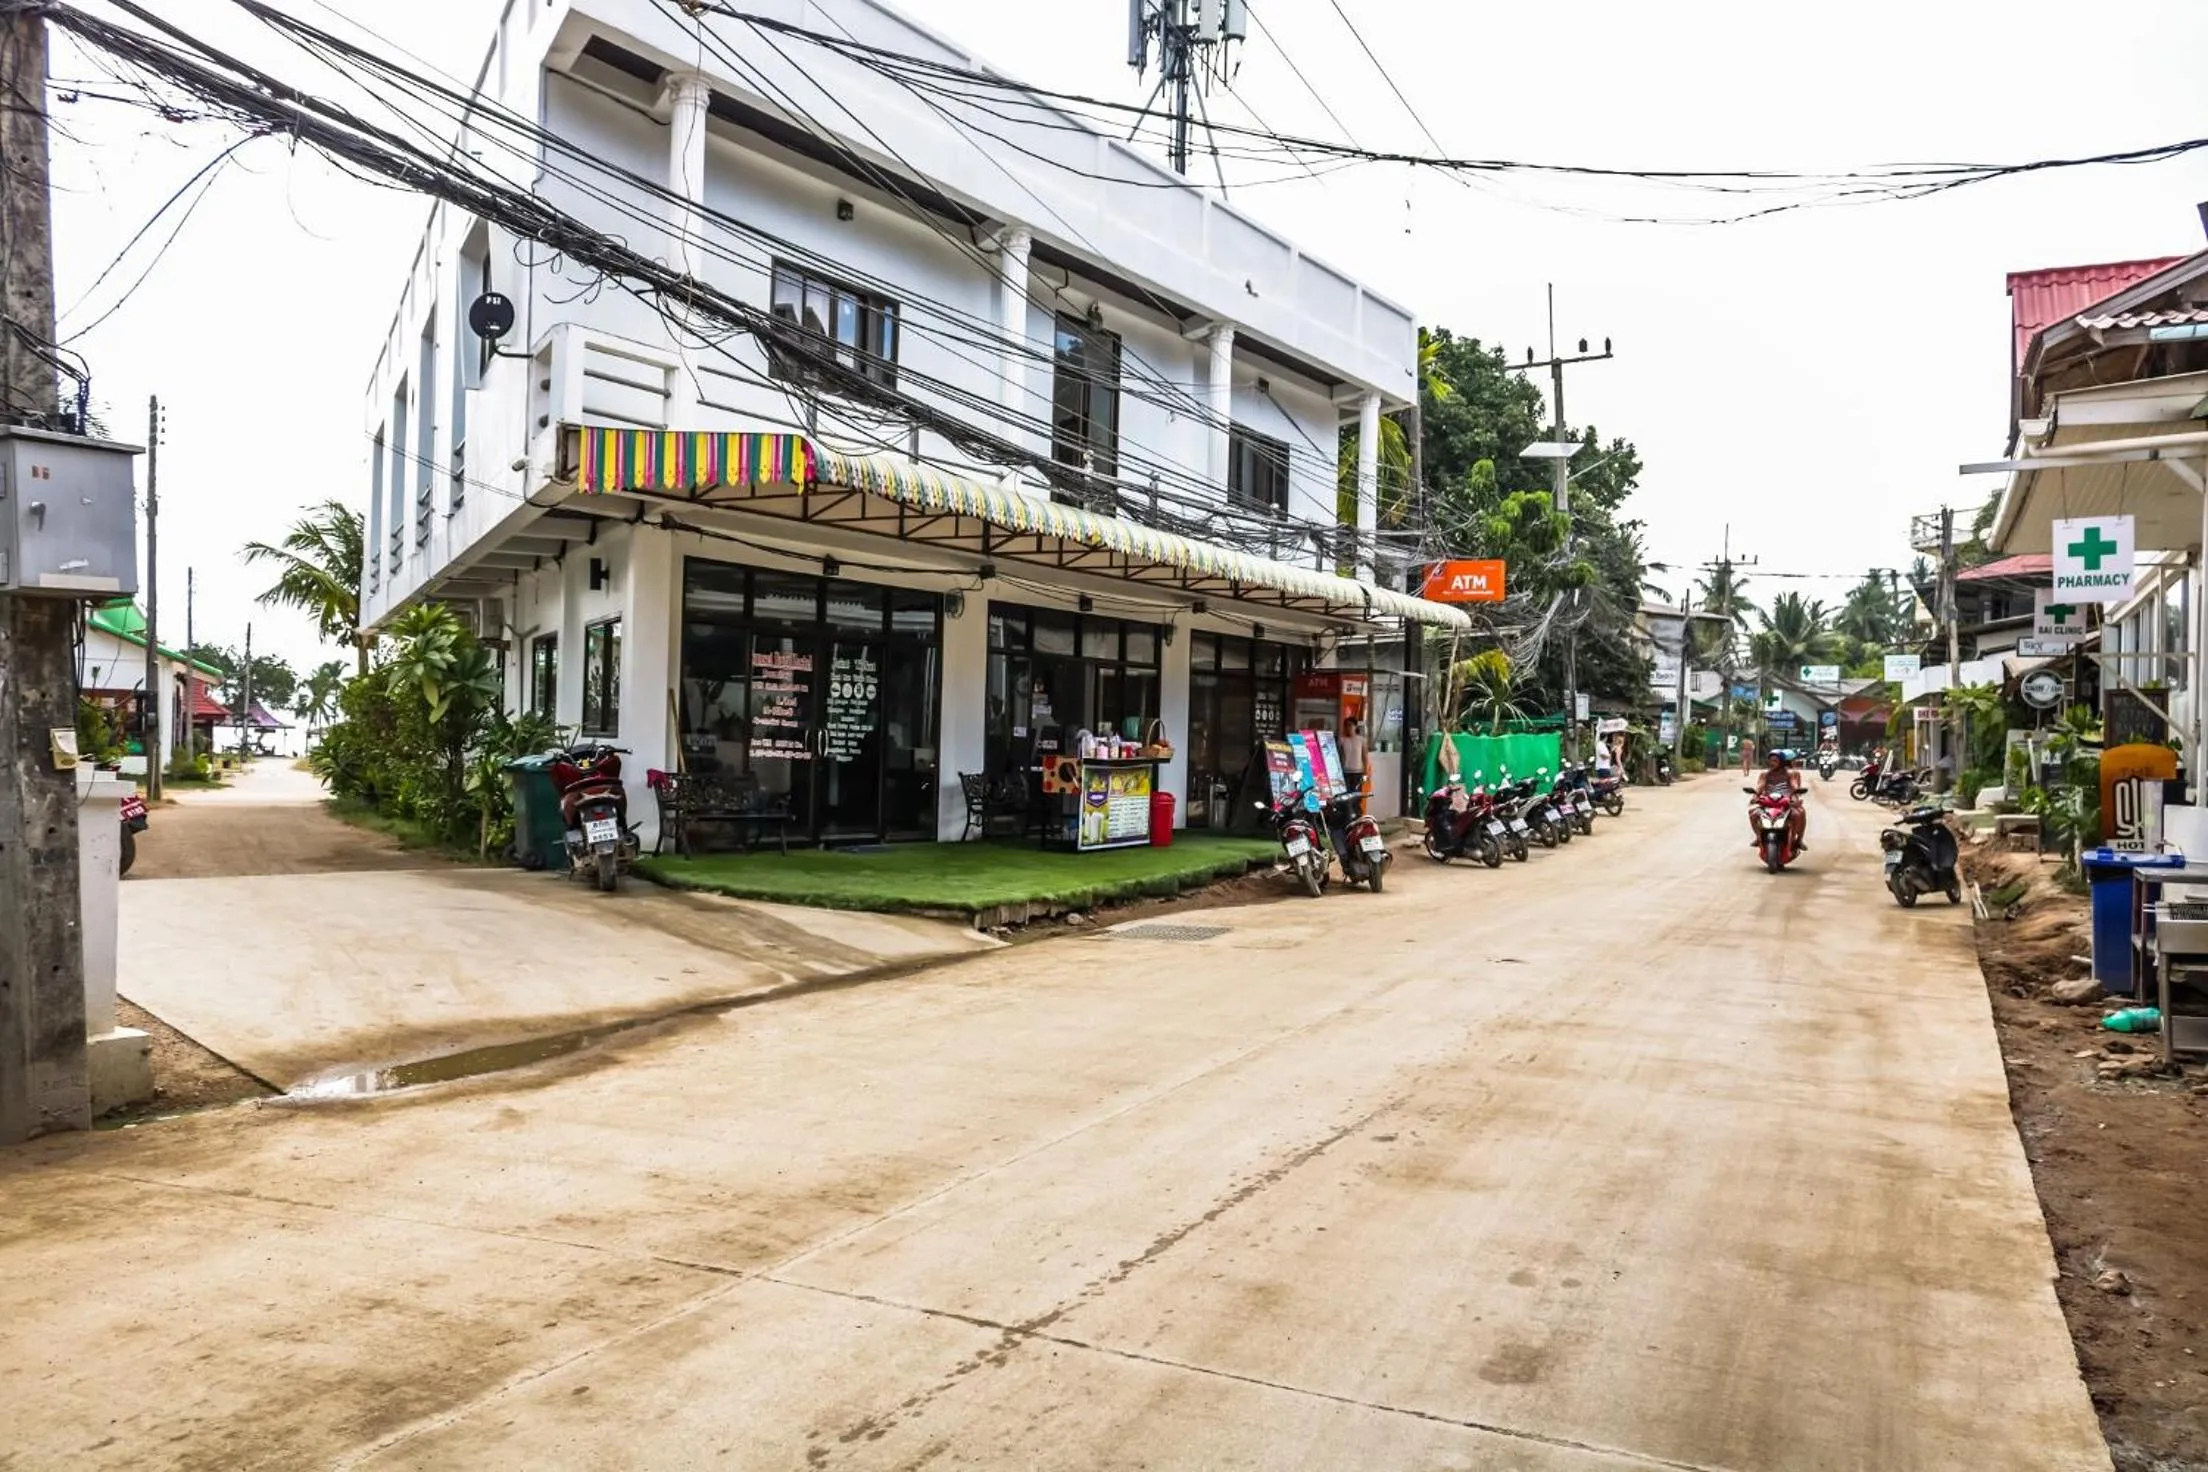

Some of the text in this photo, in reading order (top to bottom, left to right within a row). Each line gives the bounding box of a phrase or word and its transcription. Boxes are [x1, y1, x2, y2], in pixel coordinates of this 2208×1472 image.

[1450, 575, 1487, 590] ATM
[2057, 573, 2131, 589] PHARMACY
[2054, 626, 2083, 635] CLINIC
